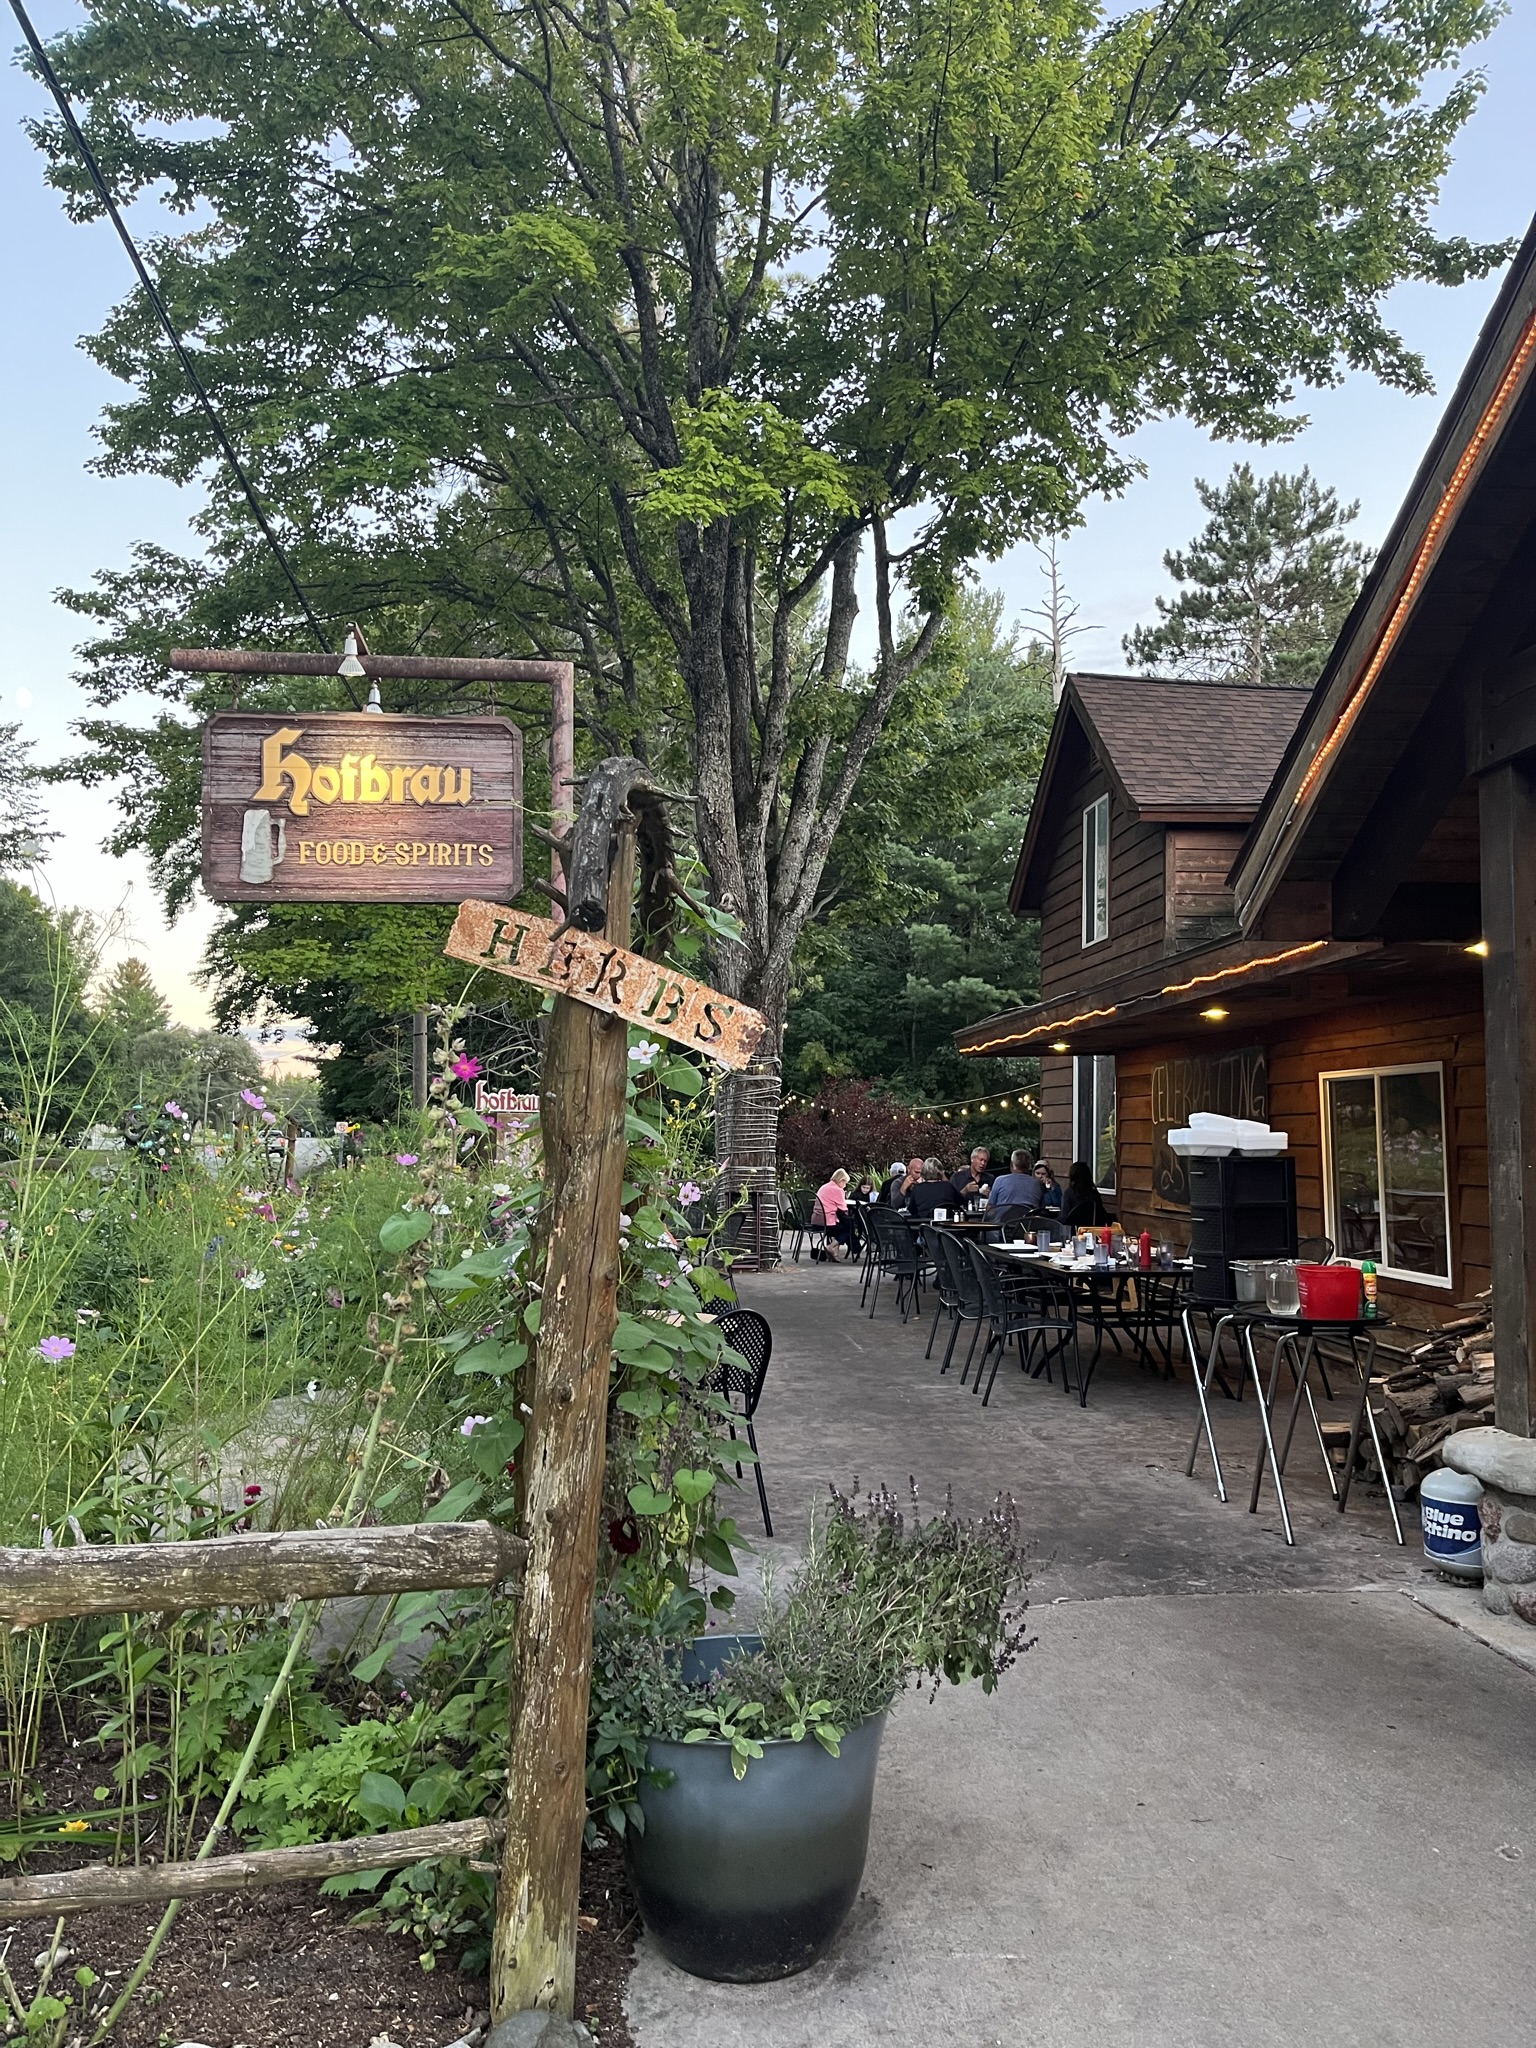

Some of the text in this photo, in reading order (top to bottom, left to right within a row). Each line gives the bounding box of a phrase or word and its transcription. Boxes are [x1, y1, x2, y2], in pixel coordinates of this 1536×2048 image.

[299, 841, 494, 867] FOOD & SPIRITS
[479, 918, 735, 1044] HERBS
[1425, 1506, 1465, 1526] Blue
[1424, 1522, 1477, 1543] Rhino
